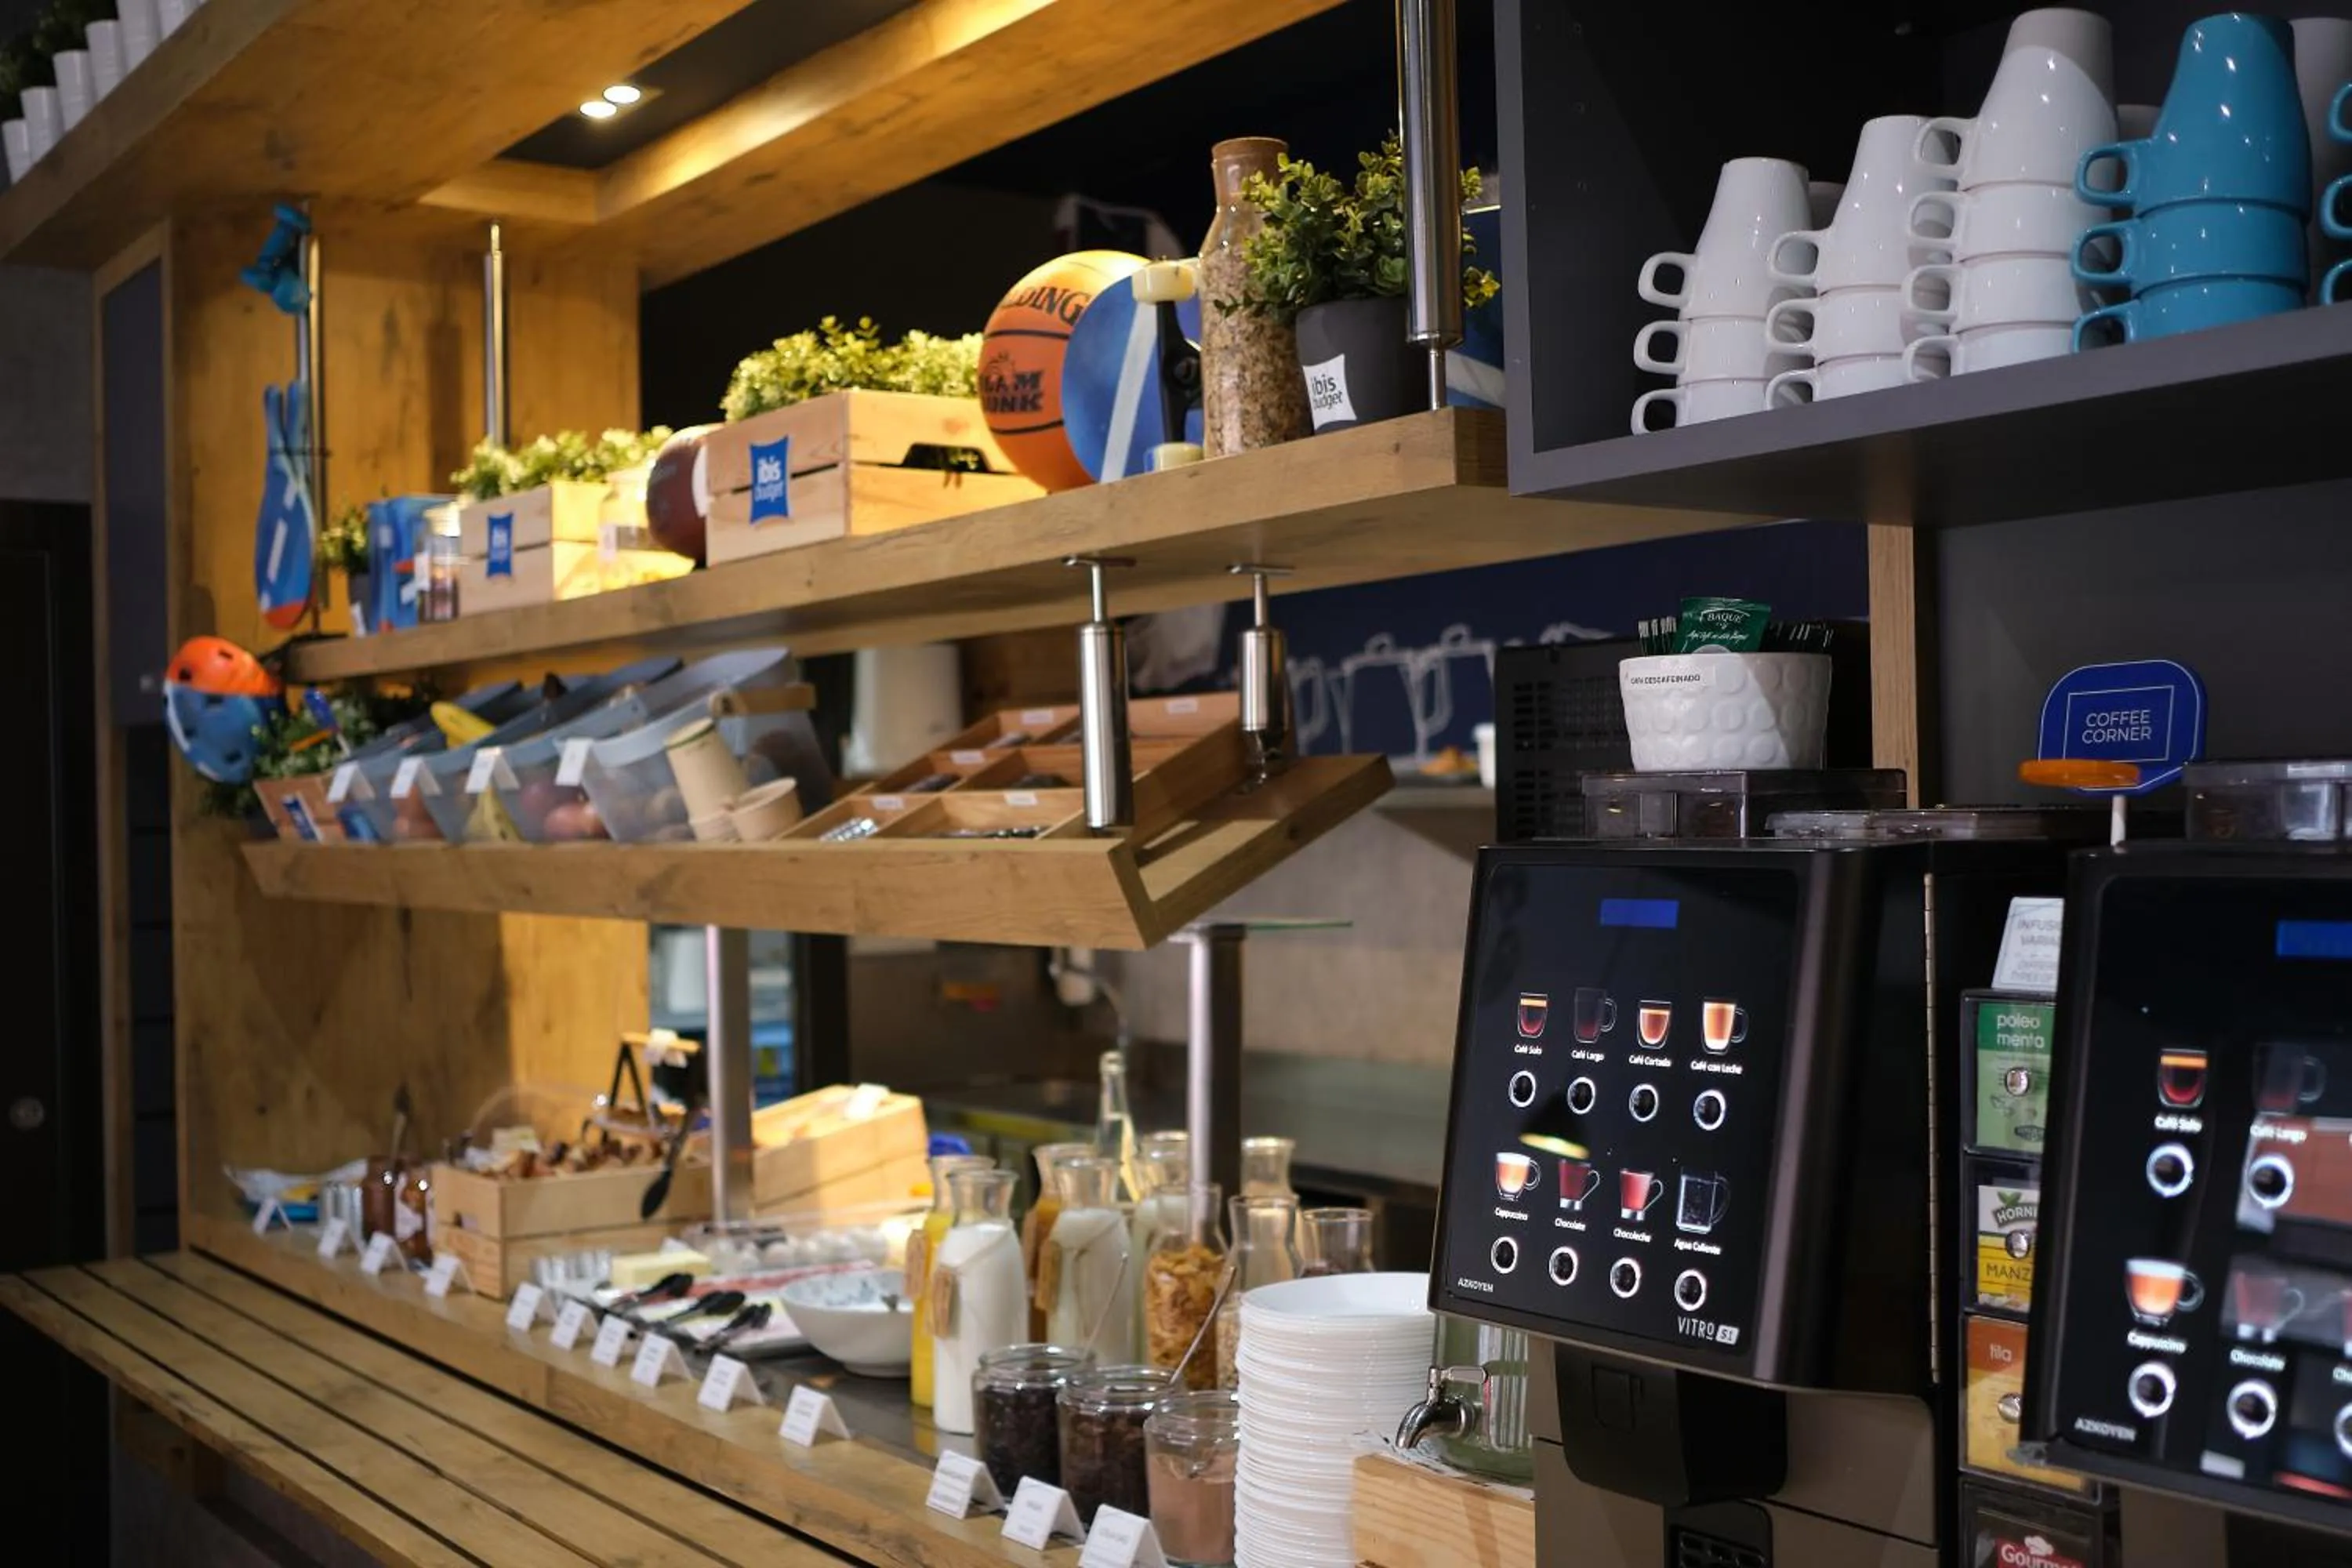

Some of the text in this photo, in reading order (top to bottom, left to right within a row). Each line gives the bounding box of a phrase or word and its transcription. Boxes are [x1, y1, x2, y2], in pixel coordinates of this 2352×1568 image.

[1000, 285, 1091, 326] DING
[1311, 373, 1337, 397] ibis
[2085, 710, 2151, 727] COFFEE
[2082, 726, 2152, 744] CORNER
[1997, 1013, 2041, 1029] poleo
[1997, 1032, 2045, 1048] menta
[1628, 1054, 1644, 1065] Café
[1690, 1060, 1707, 1071] Café
[1986, 1263, 2031, 1281] MANZ
